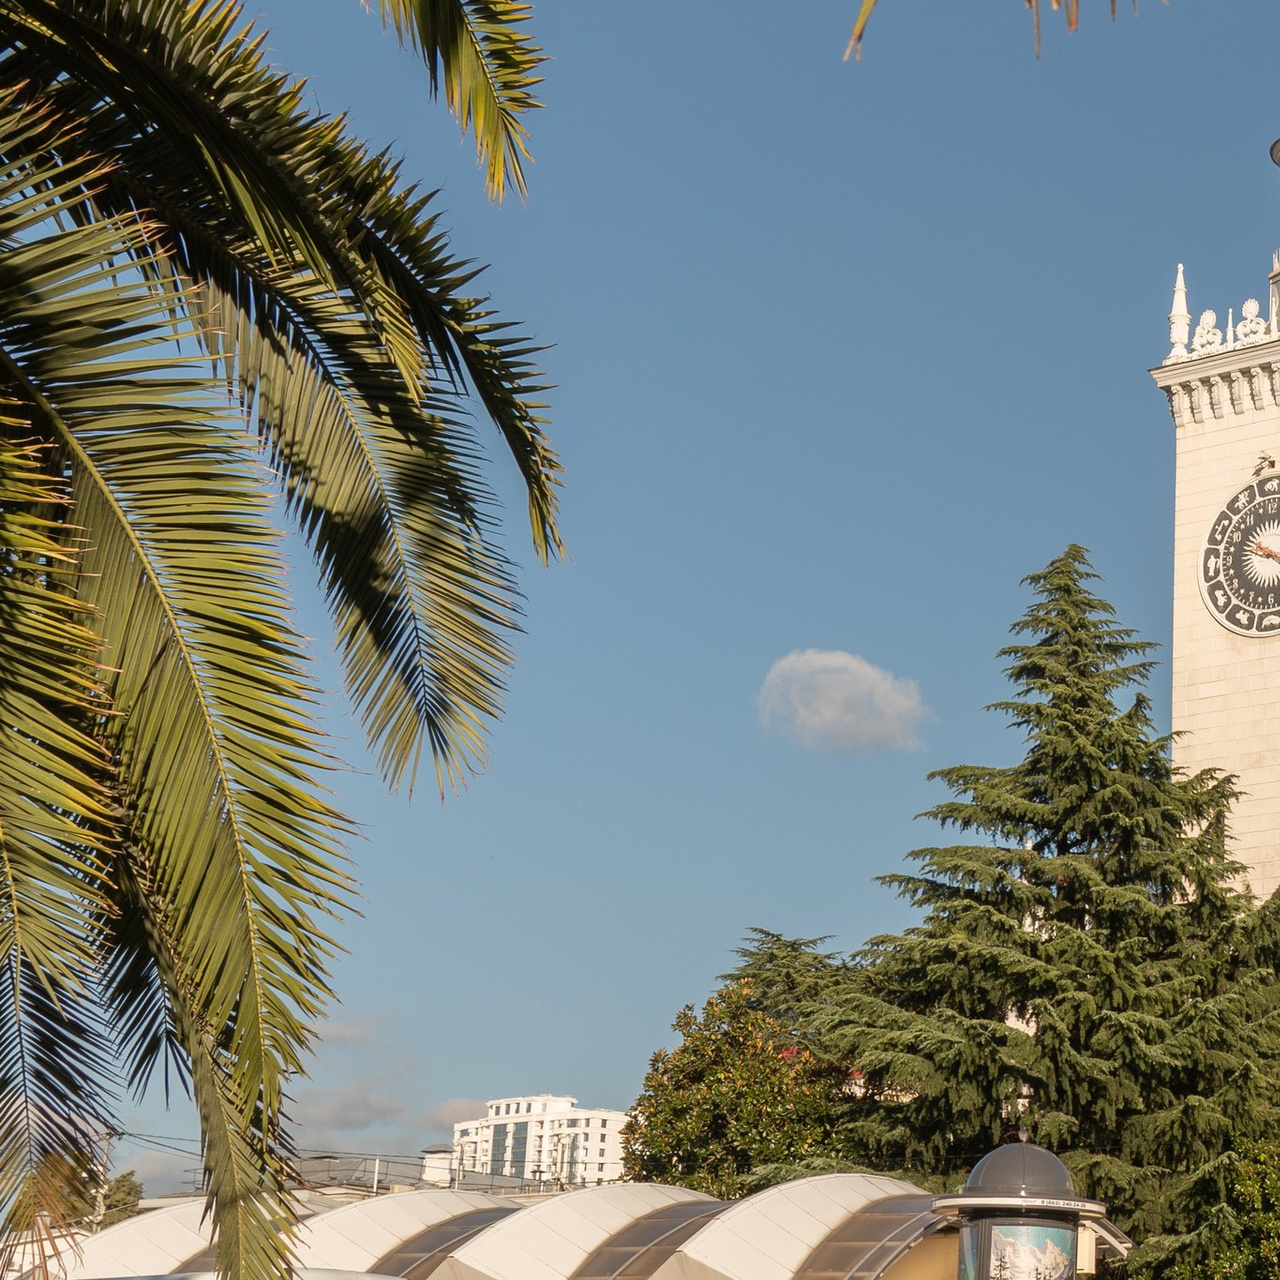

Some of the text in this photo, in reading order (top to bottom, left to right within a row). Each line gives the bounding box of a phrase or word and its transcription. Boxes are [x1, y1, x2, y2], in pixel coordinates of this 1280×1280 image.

[1268, 502, 1277, 514] 12
[1246, 514, 1254, 526] 11
[1233, 531, 1242, 543] 10
[1226, 555, 1233, 566] 9
[1232, 578, 1239, 589] 8
[1268, 593, 1275, 604] 6
